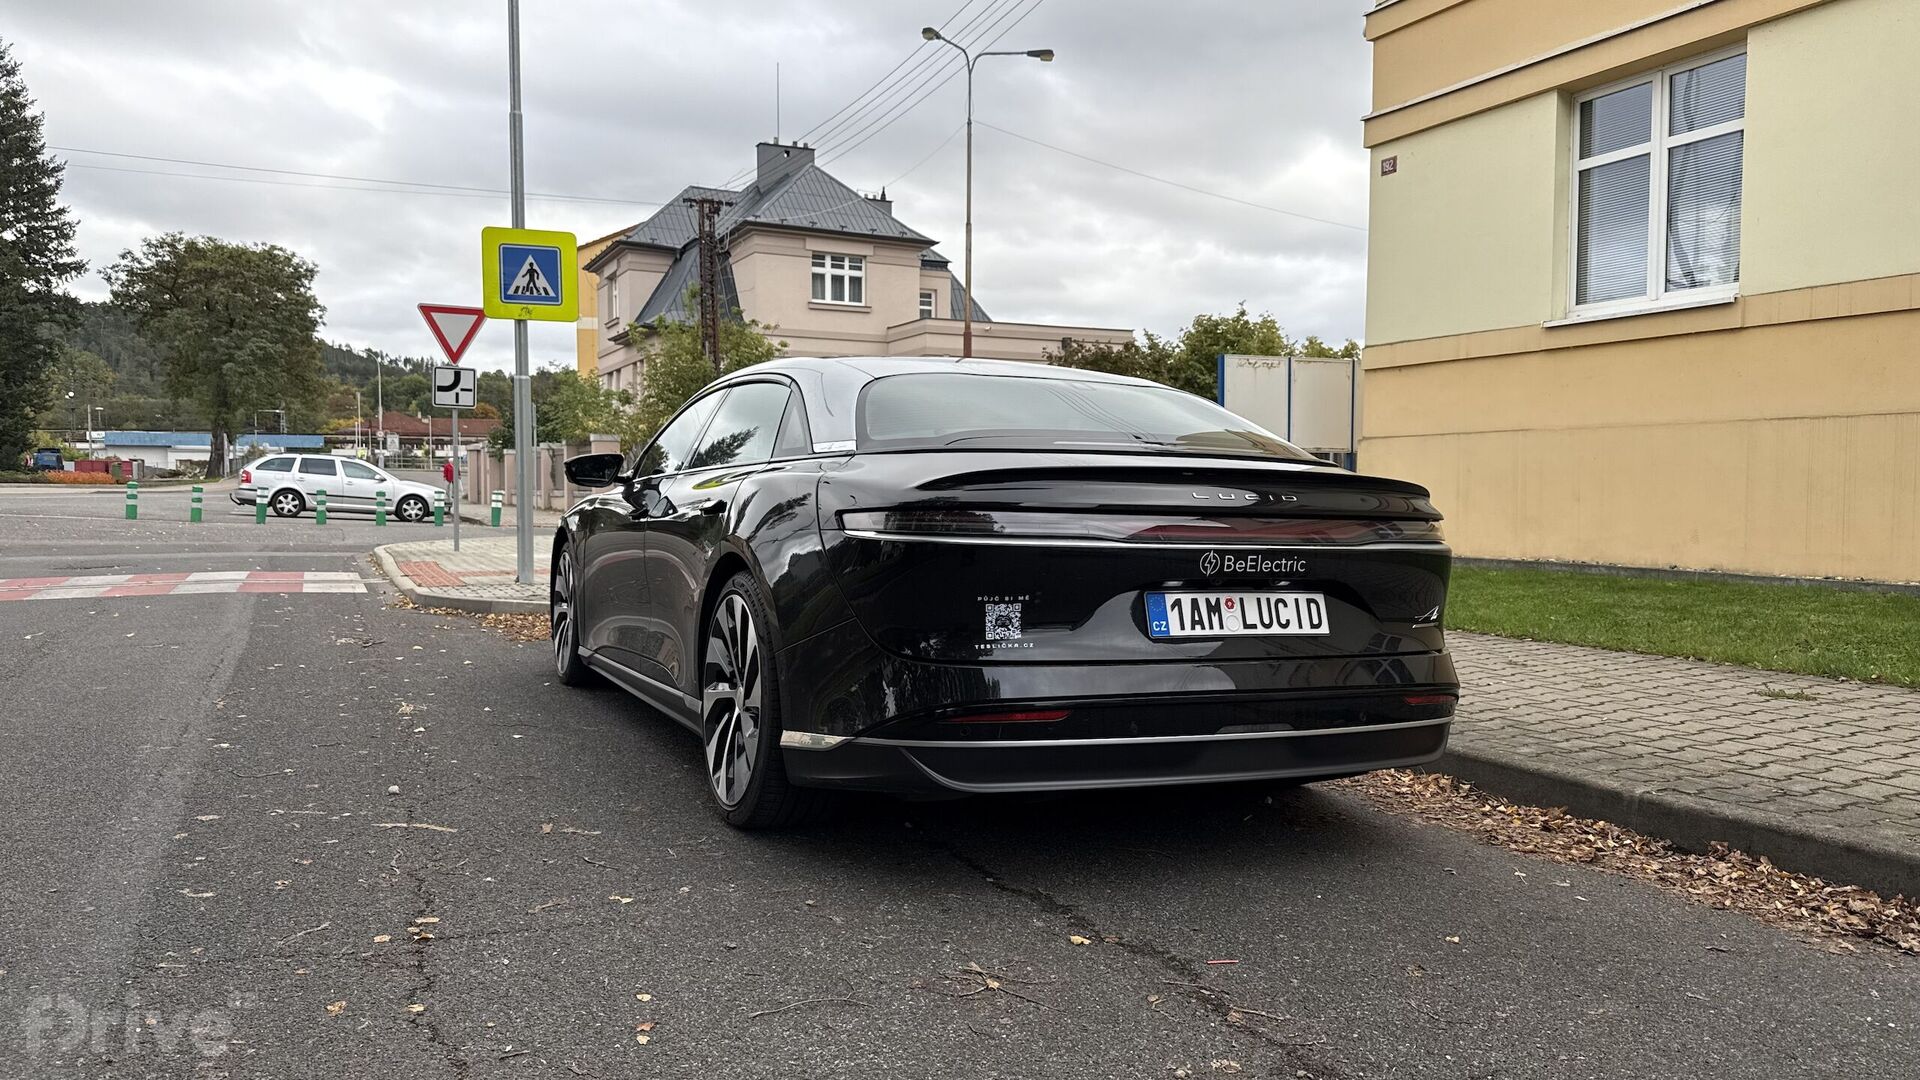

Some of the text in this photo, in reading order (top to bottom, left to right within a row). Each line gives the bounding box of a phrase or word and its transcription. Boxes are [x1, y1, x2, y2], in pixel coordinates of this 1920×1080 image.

[1192, 492, 1298, 501] LUCID
[1223, 554, 1307, 572] BeElectric
[1170, 596, 1323, 631] 1AM LUCID
[1152, 620, 1168, 632] CZ
